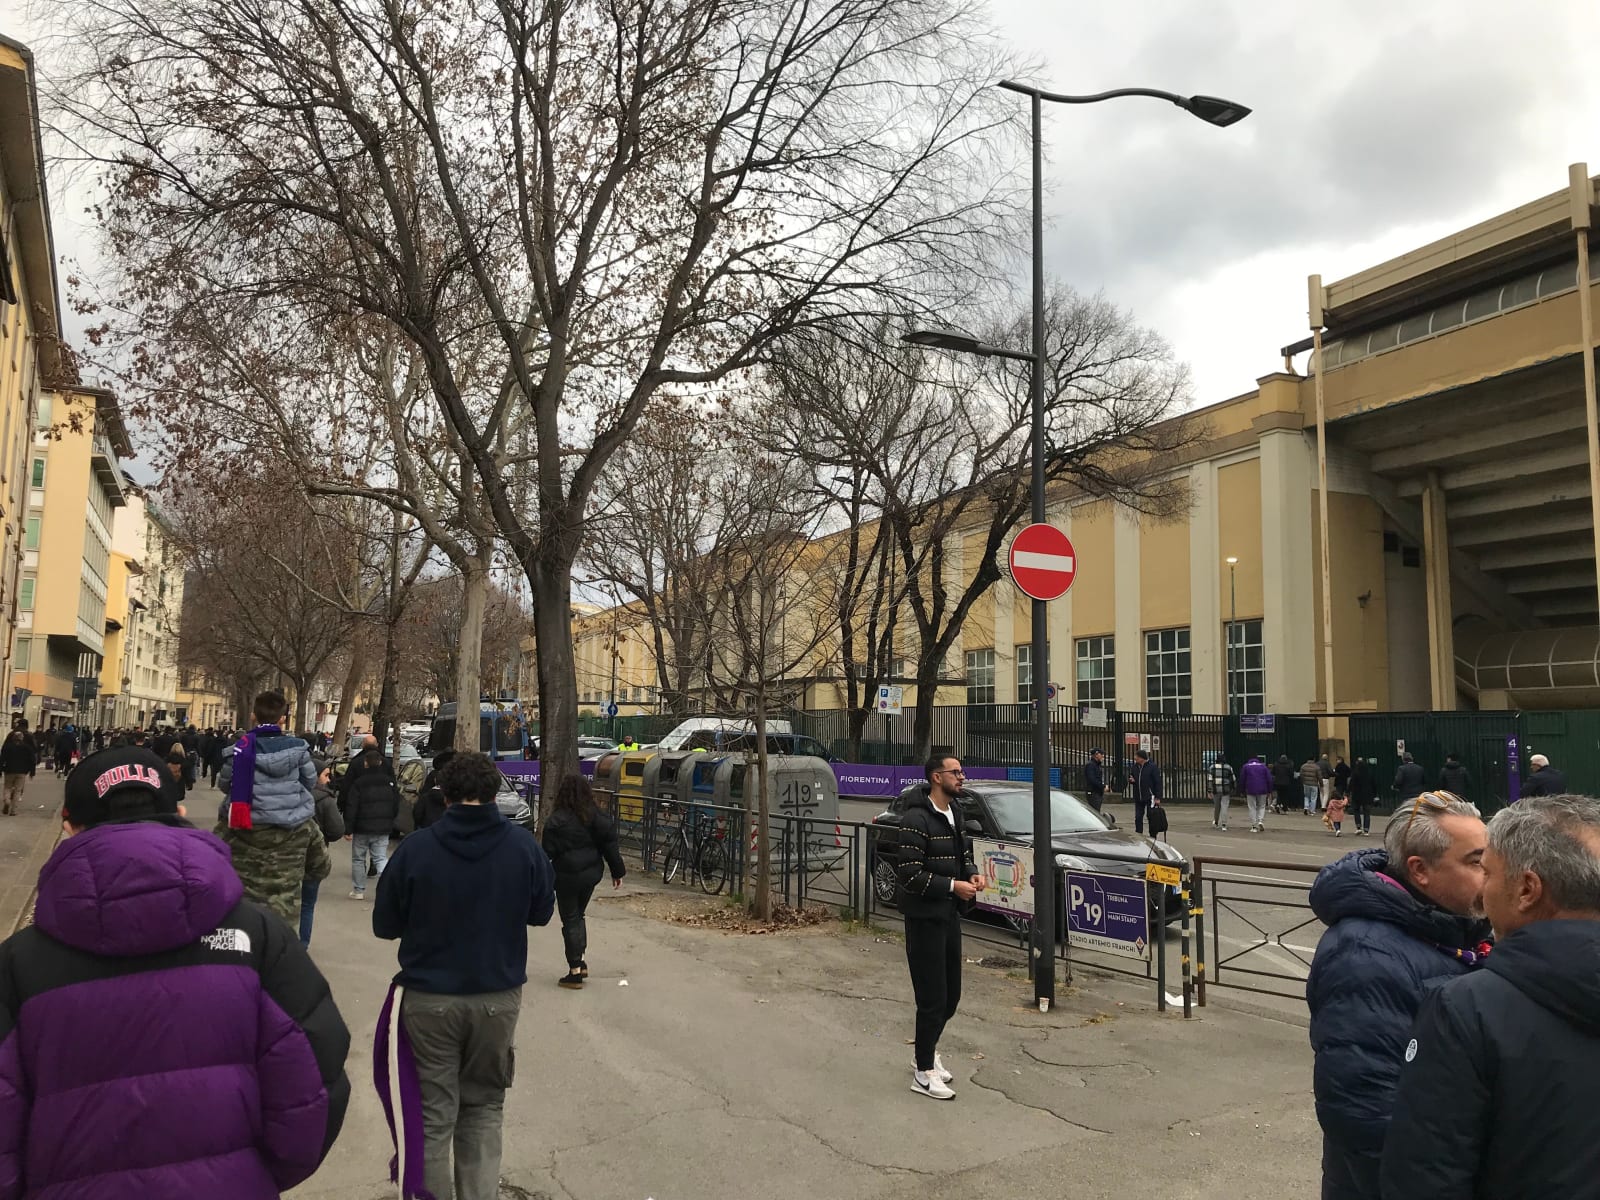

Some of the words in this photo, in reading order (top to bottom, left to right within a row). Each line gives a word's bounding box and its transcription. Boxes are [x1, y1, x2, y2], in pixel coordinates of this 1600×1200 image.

[94, 764, 161, 798] BULLS
[840, 775, 890, 784] FIORENTINA
[1106, 895, 1128, 903] TRIBUNA
[1121, 915, 1137, 924] STAND
[216, 928, 235, 937] THE
[200, 935, 235, 944] NORTH
[1070, 934, 1087, 944] STADIO
[1088, 938, 1111, 948] ARTEMIO
[1111, 942, 1136, 953] FRANCHI
[210, 943, 235, 951] FACE
